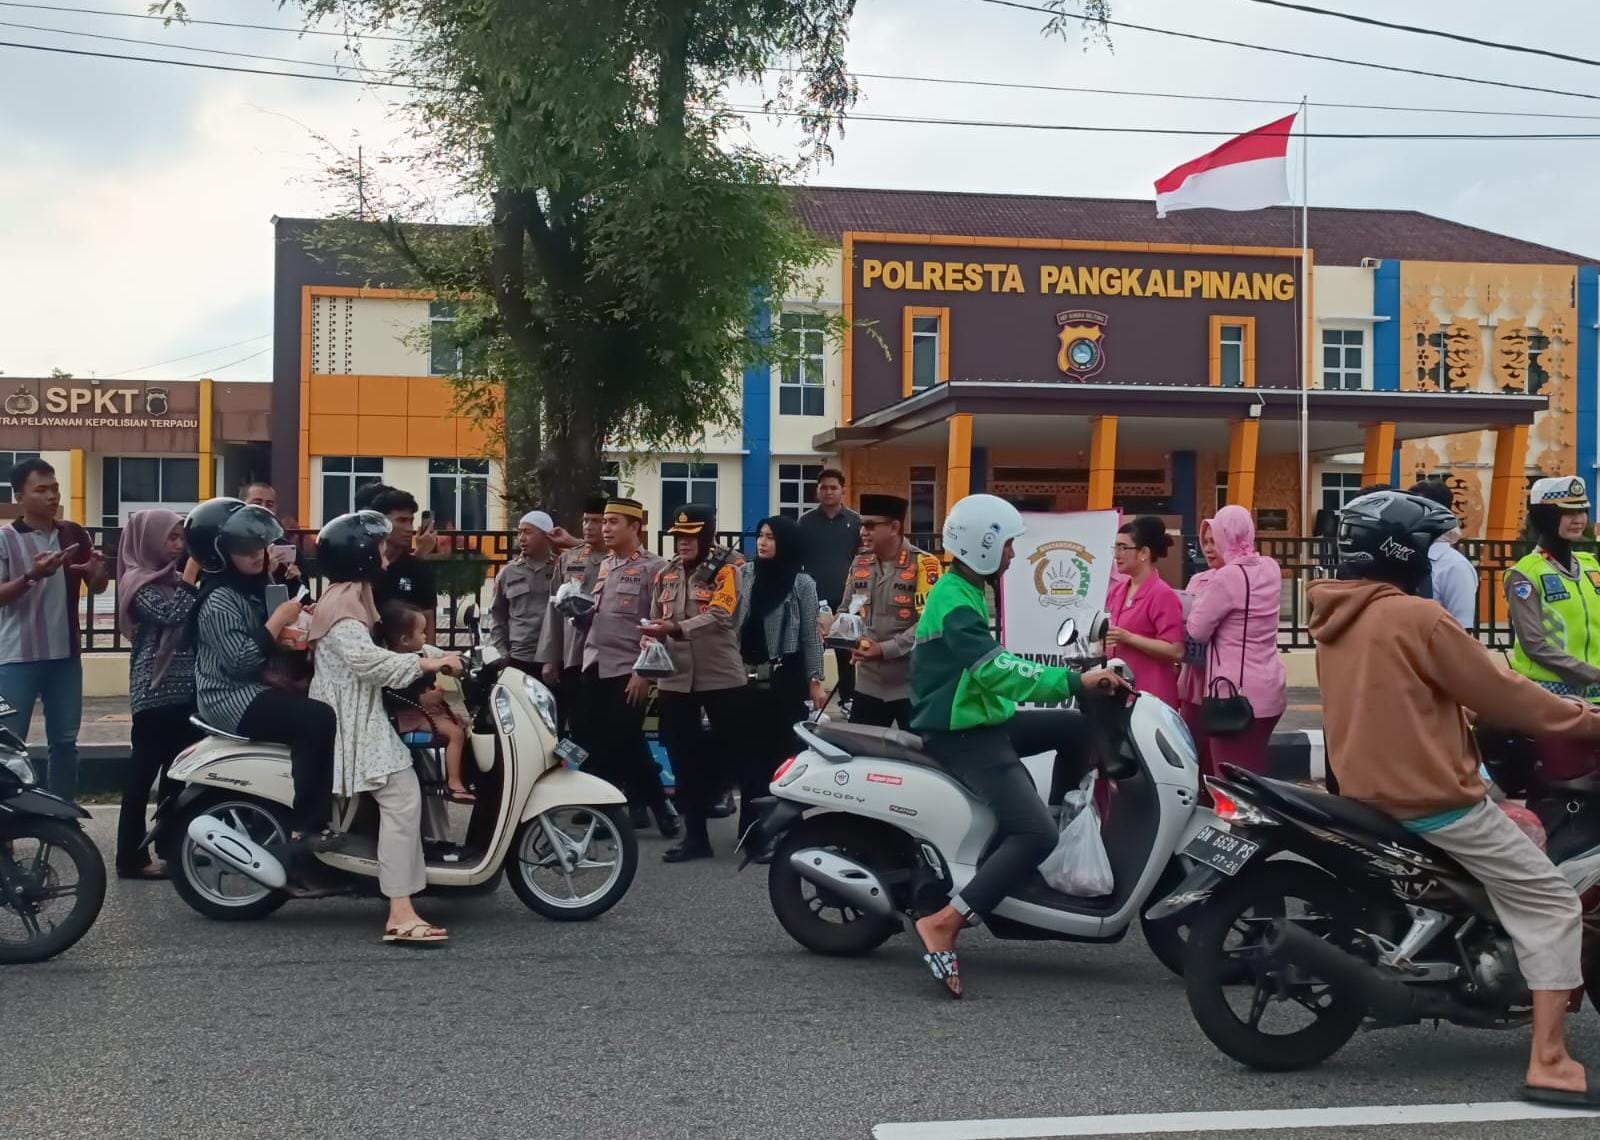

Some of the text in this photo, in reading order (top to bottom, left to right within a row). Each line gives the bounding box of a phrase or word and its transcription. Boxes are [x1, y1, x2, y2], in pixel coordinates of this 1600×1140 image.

[863, 259, 1295, 301] POLRESTA PANGKALPINANG
[46, 387, 140, 414] SPKT
[20, 417, 83, 427] PELAYANAN
[85, 418, 148, 428] KEPOLISIAN
[150, 419, 198, 428] TERPADU
[801, 785, 866, 804] SCOOPY
[1196, 825, 1216, 842] BN
[1235, 843, 1256, 859] PS
